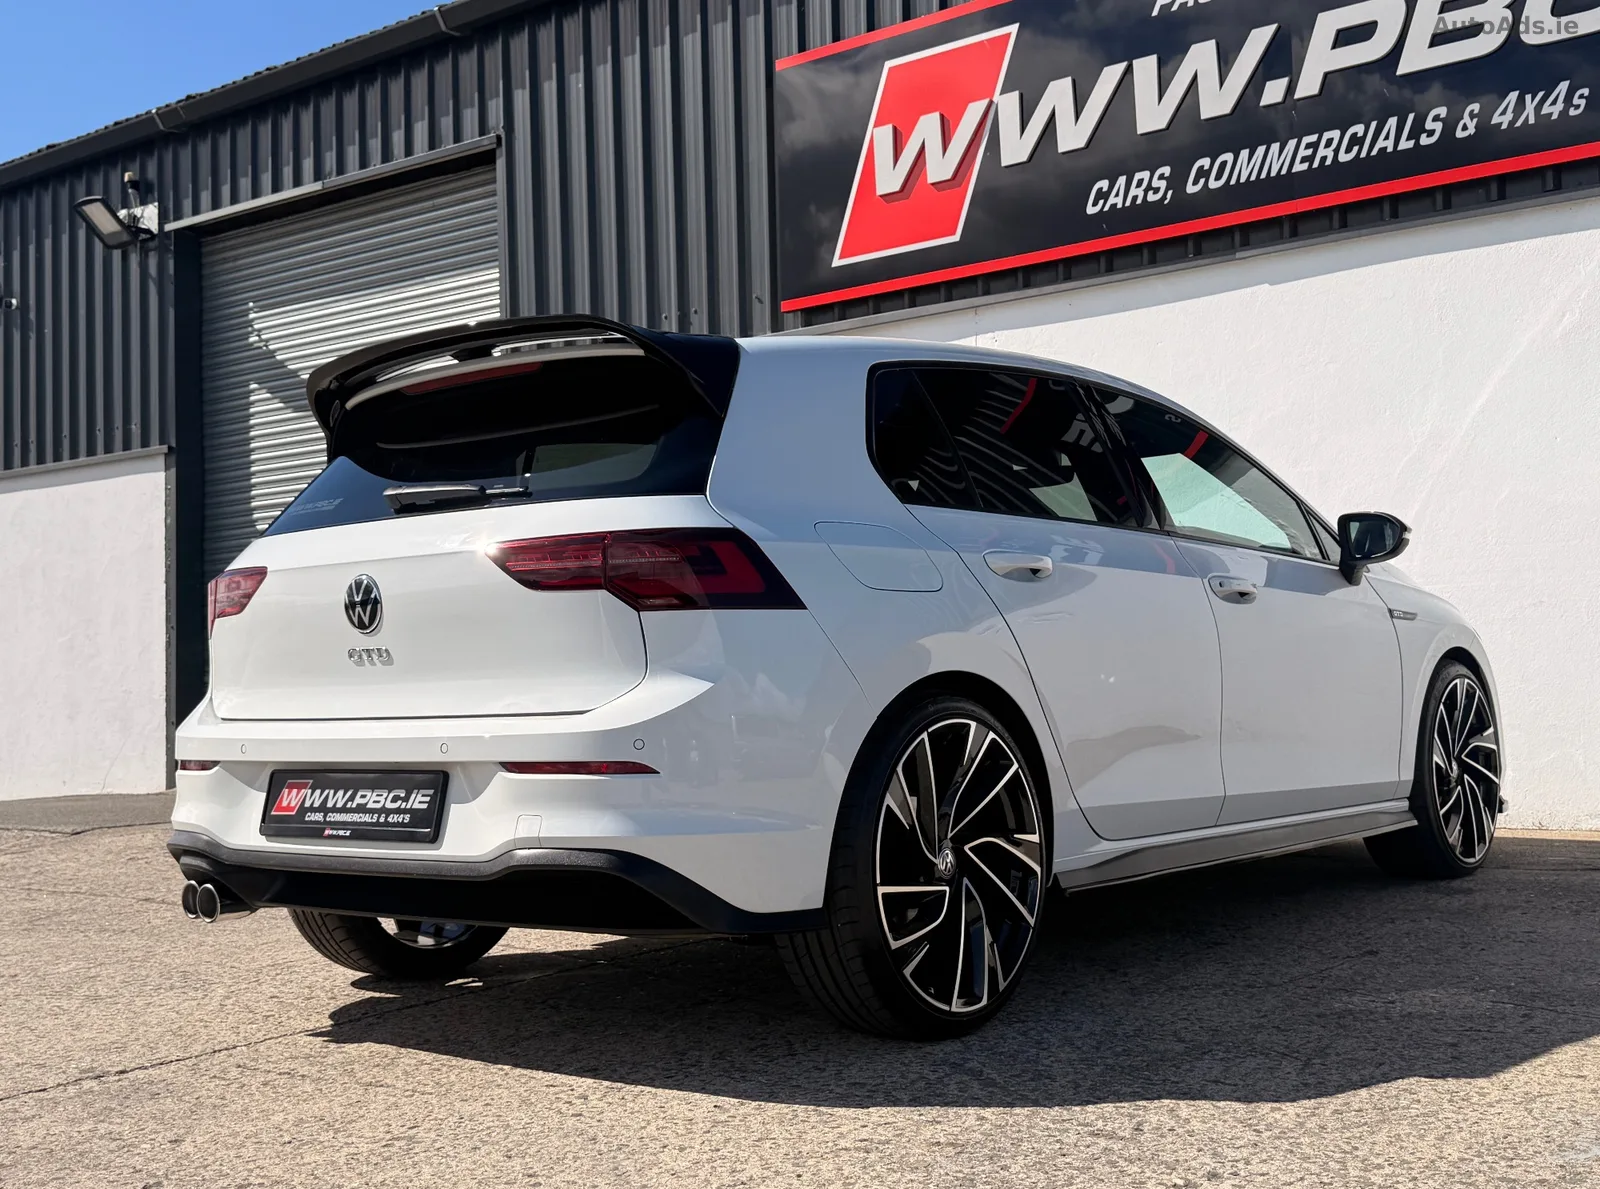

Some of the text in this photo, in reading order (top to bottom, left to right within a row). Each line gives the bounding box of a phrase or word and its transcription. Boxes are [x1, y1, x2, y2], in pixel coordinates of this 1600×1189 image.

[1086, 166, 1174, 215] CARS,
[1186, 106, 1447, 194] COMMERCIALS
[1456, 103, 1481, 138] &
[281, 788, 435, 809] WWW.PBC.IE
[305, 812, 324, 823] CARS,
[326, 812, 379, 823] COMMERCIALS
[379, 813, 386, 823] &
